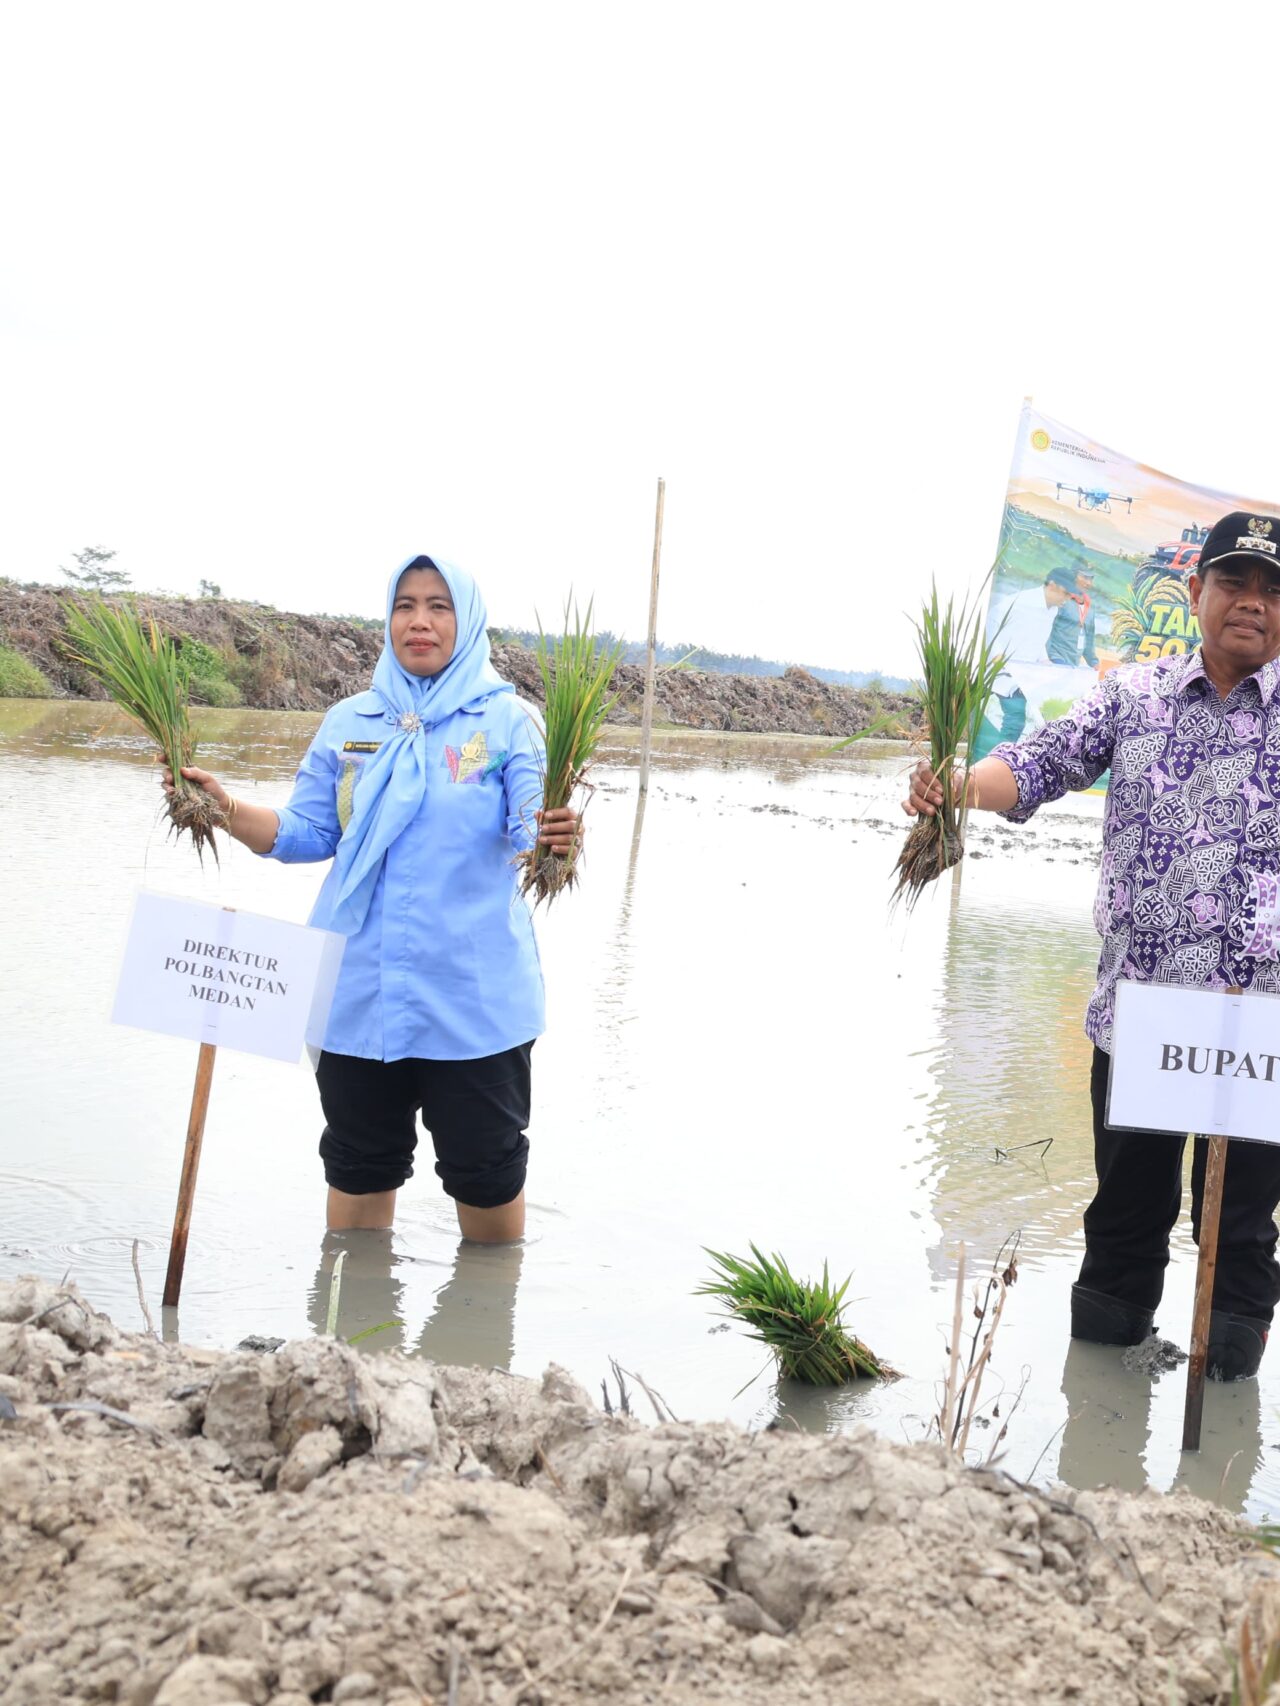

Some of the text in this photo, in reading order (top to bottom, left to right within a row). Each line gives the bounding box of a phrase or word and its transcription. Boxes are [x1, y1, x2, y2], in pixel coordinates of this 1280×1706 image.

[1052, 440, 1086, 453] KEMENTERIA
[1150, 604, 1202, 637] TAN
[1134, 635, 1202, 663] 50
[183, 939, 279, 972] DIREKTUR
[164, 957, 289, 996] POLBANGTAN
[188, 984, 256, 1011] MEDAN
